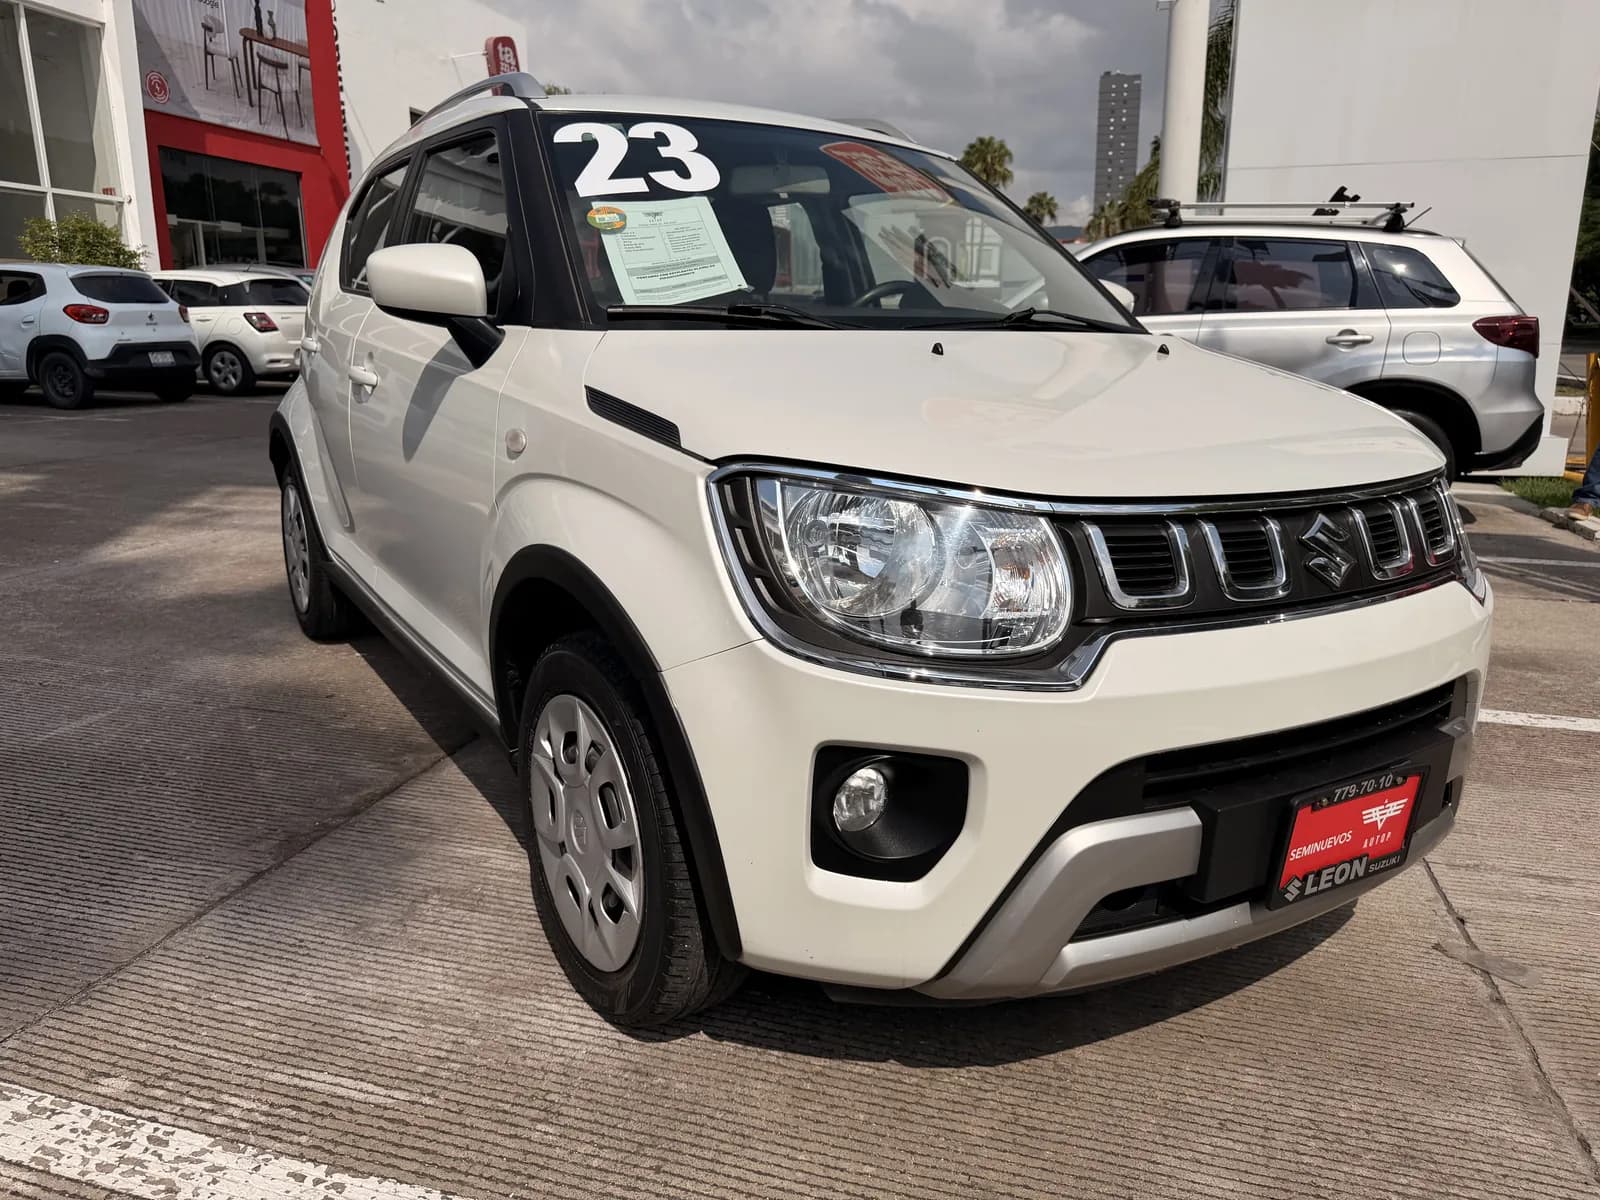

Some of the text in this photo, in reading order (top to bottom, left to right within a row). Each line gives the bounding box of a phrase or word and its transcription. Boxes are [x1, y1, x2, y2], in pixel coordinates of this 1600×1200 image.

[553, 122, 720, 198] 23
[1289, 831, 1352, 861] SEMINUEVOS
[1304, 855, 1401, 896] LEON SUZUKI
